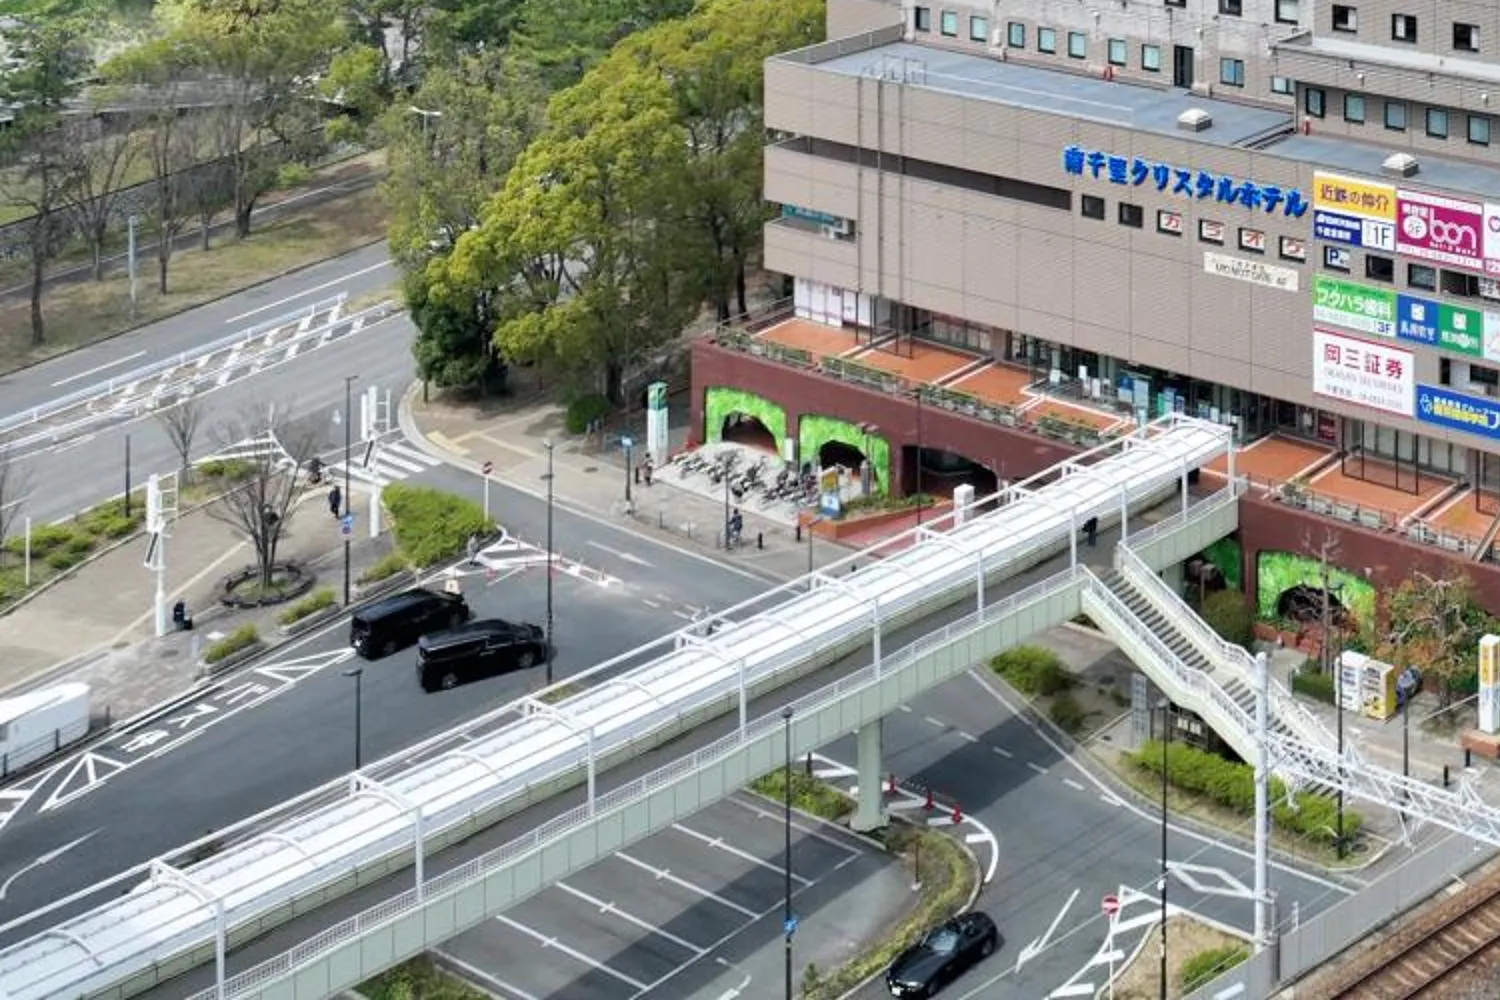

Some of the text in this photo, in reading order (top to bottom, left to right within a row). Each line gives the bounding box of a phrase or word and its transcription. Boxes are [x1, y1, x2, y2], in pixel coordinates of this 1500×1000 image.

[1063, 145, 1309, 217] 南千里クリスタルホテル
[1373, 226, 1391, 247] 1F
[1329, 248, 1339, 263] P
[1378, 321, 1392, 334] 3F
[1324, 343, 1402, 379] 岡三証券
